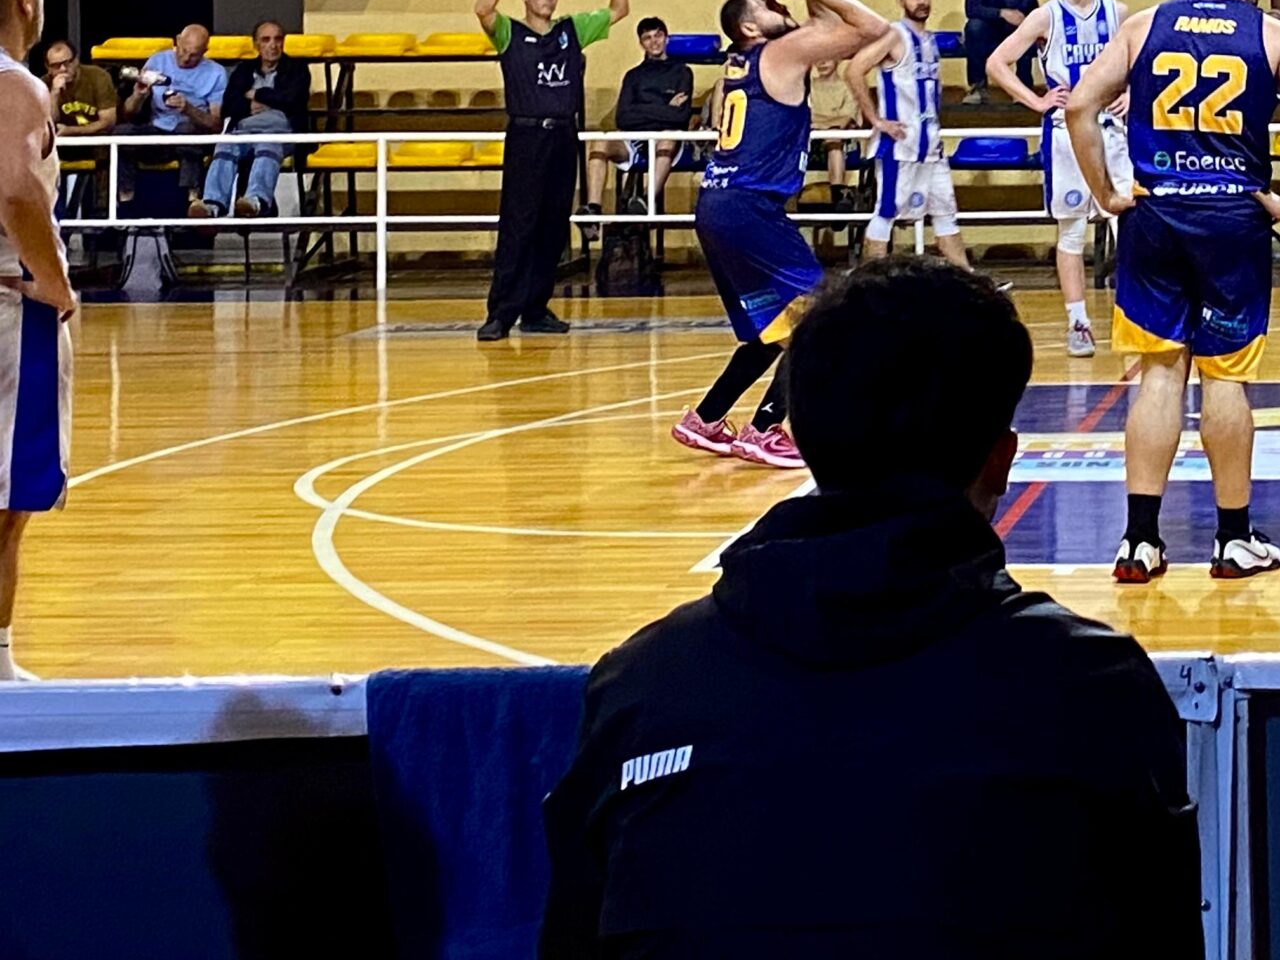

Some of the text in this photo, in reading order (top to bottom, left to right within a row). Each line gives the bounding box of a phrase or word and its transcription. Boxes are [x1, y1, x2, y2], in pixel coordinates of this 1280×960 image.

[1174, 16, 1237, 35] RAMOS
[1152, 51, 1248, 136] 22
[1175, 151, 1247, 172] Faerac
[620, 744, 694, 791] PUMA
